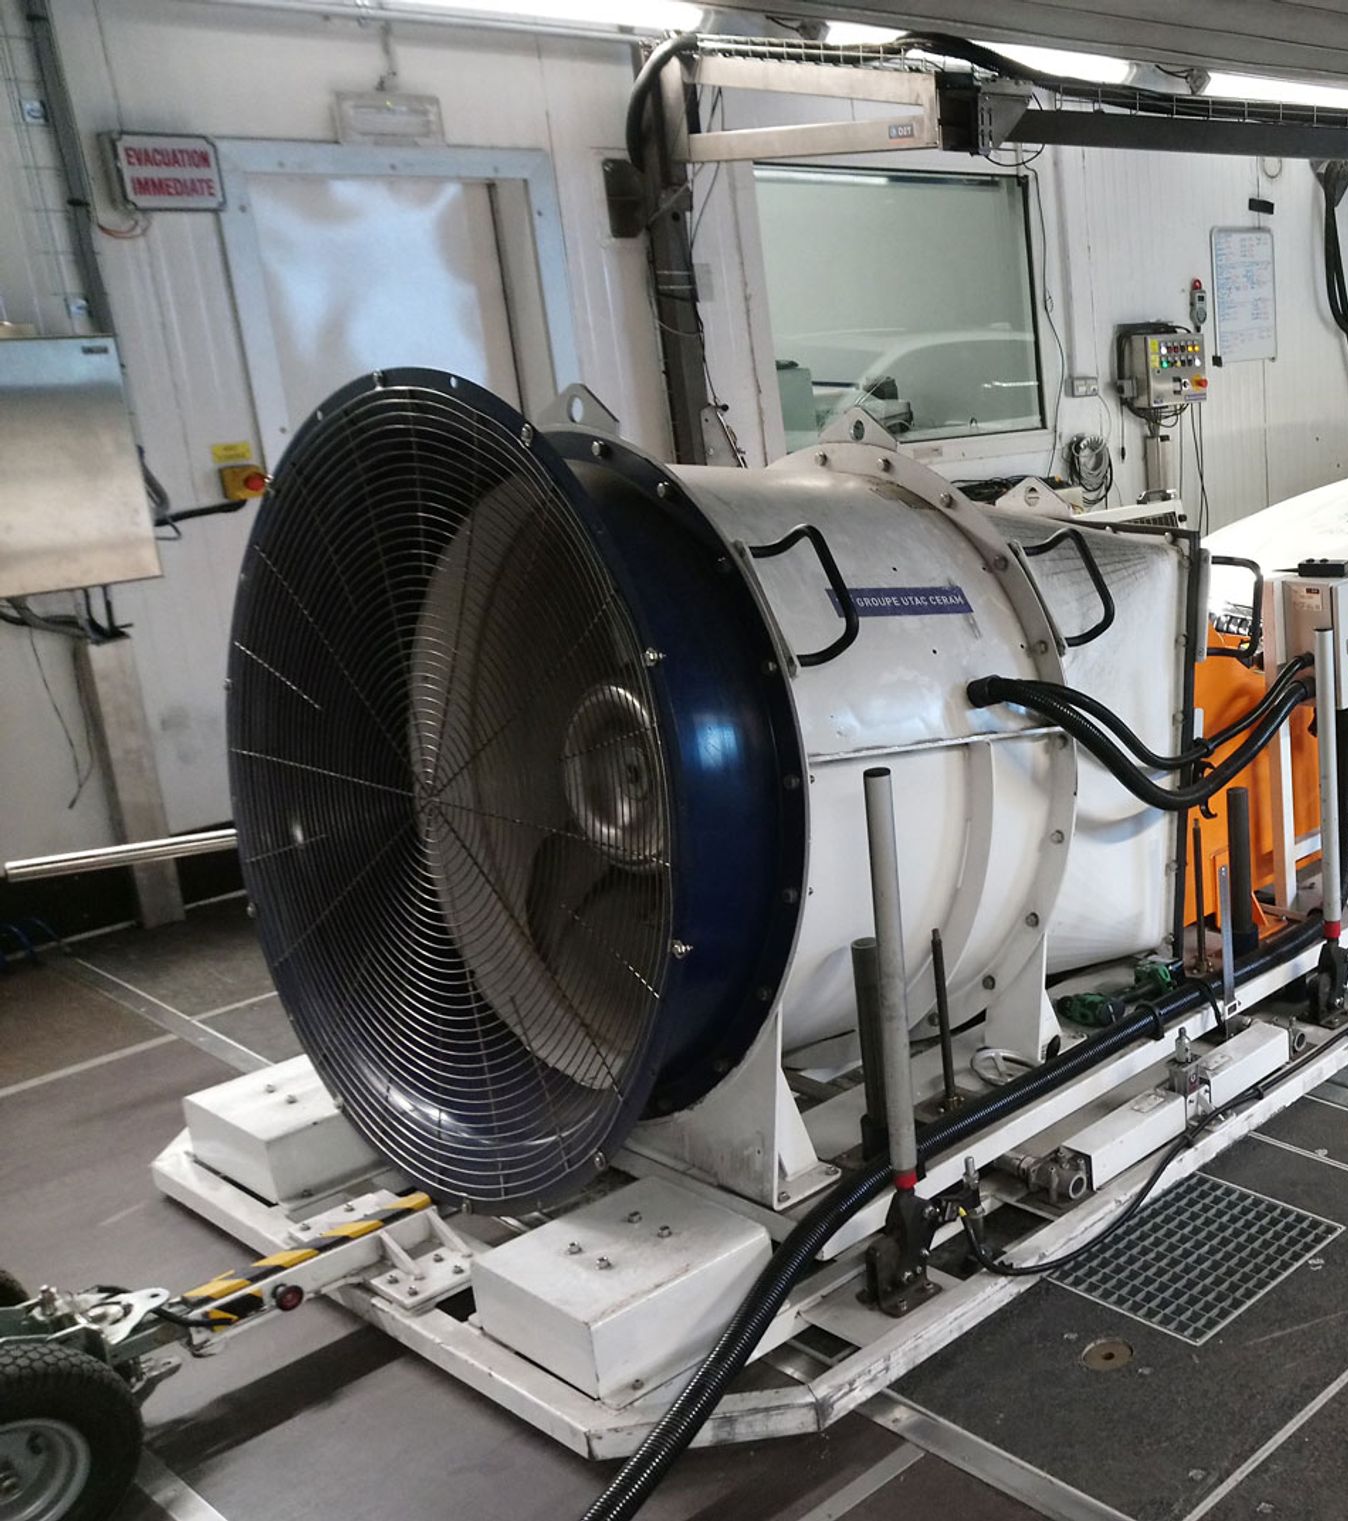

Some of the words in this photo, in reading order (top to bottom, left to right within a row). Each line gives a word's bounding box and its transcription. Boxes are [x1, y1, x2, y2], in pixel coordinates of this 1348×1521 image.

[124, 146, 211, 168] EVACUATION
[131, 176, 217, 197] IMMEDIATE
[855, 597, 900, 608] GROUPE
[900, 596, 927, 607] UTAC
[927, 595, 964, 606] CERAM
